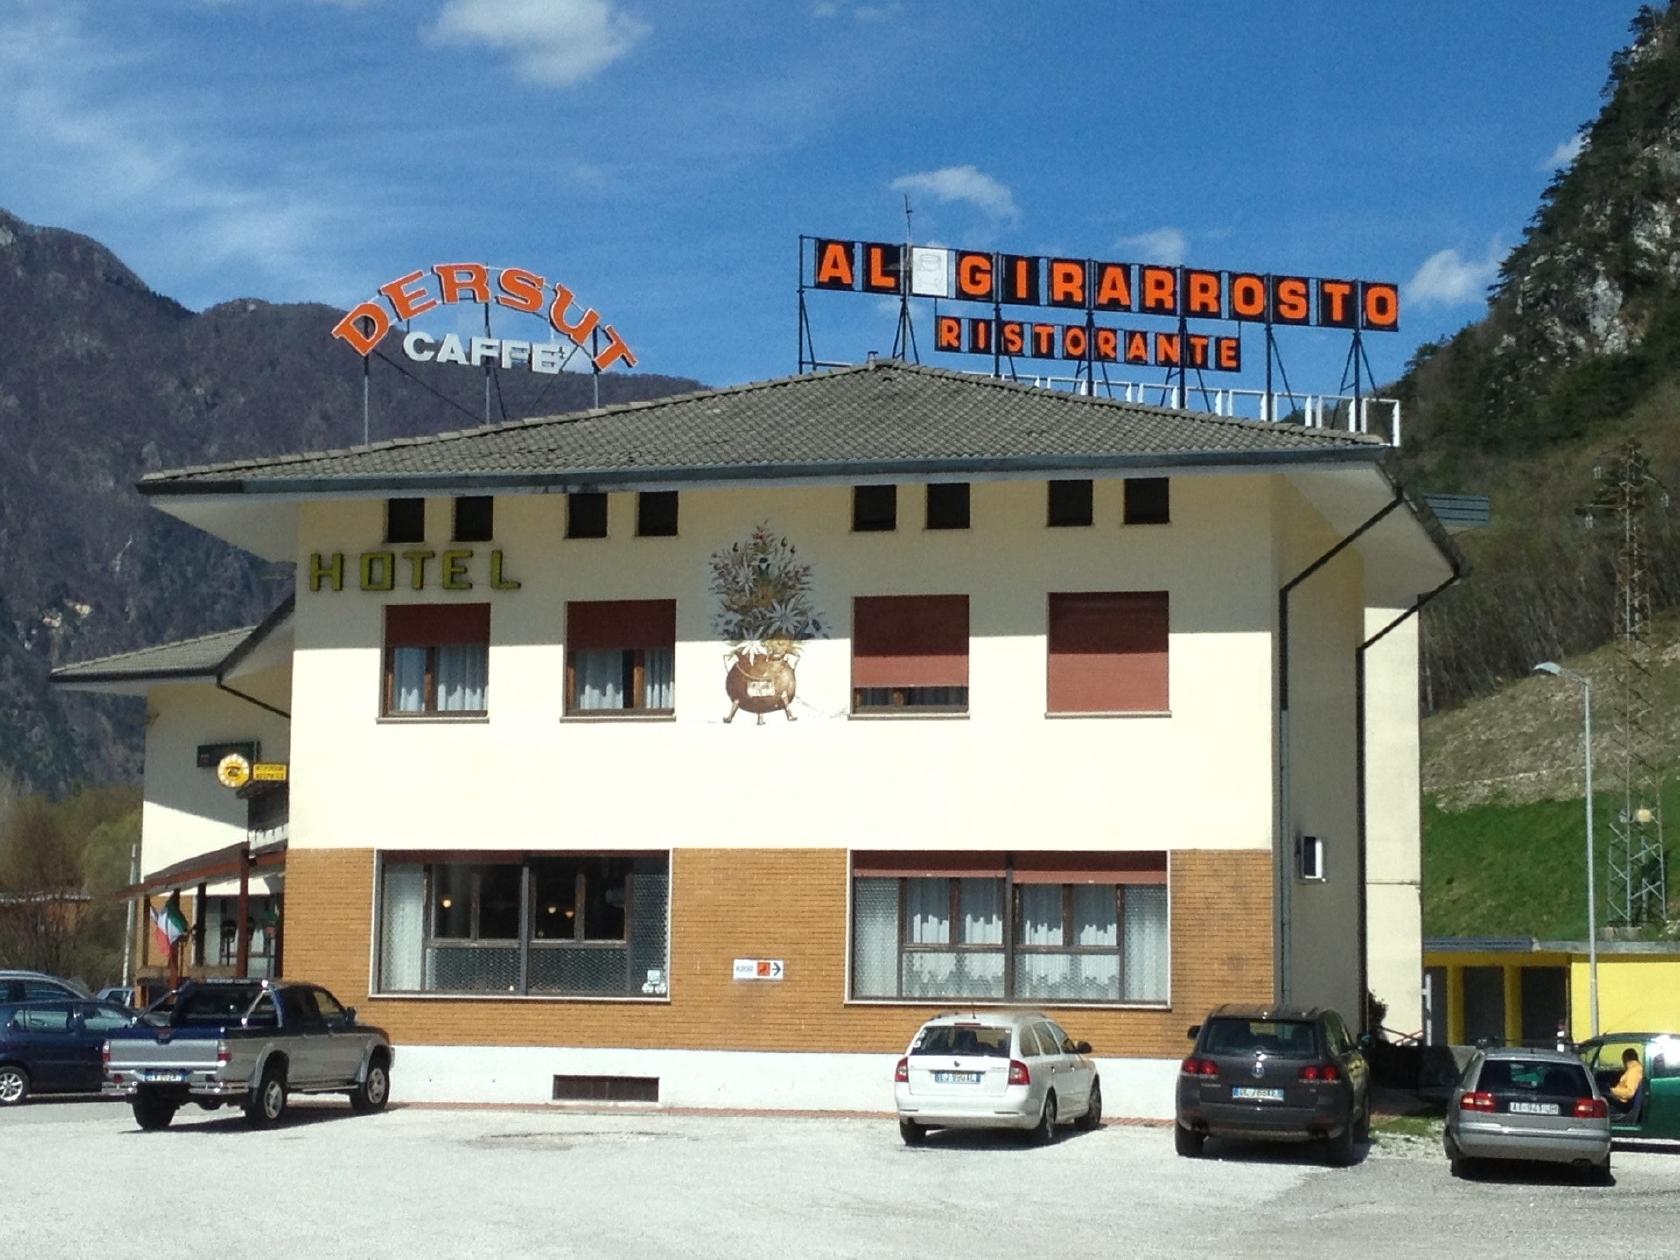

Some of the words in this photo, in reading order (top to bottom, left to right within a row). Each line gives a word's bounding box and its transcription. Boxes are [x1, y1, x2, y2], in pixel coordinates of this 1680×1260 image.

[331, 263, 638, 373] DERSUT
[817, 243, 896, 288] AL
[957, 254, 1399, 326] GIRARROSTO
[939, 317, 1240, 369] RISTORANTE
[309, 550, 522, 592] HOTEL
